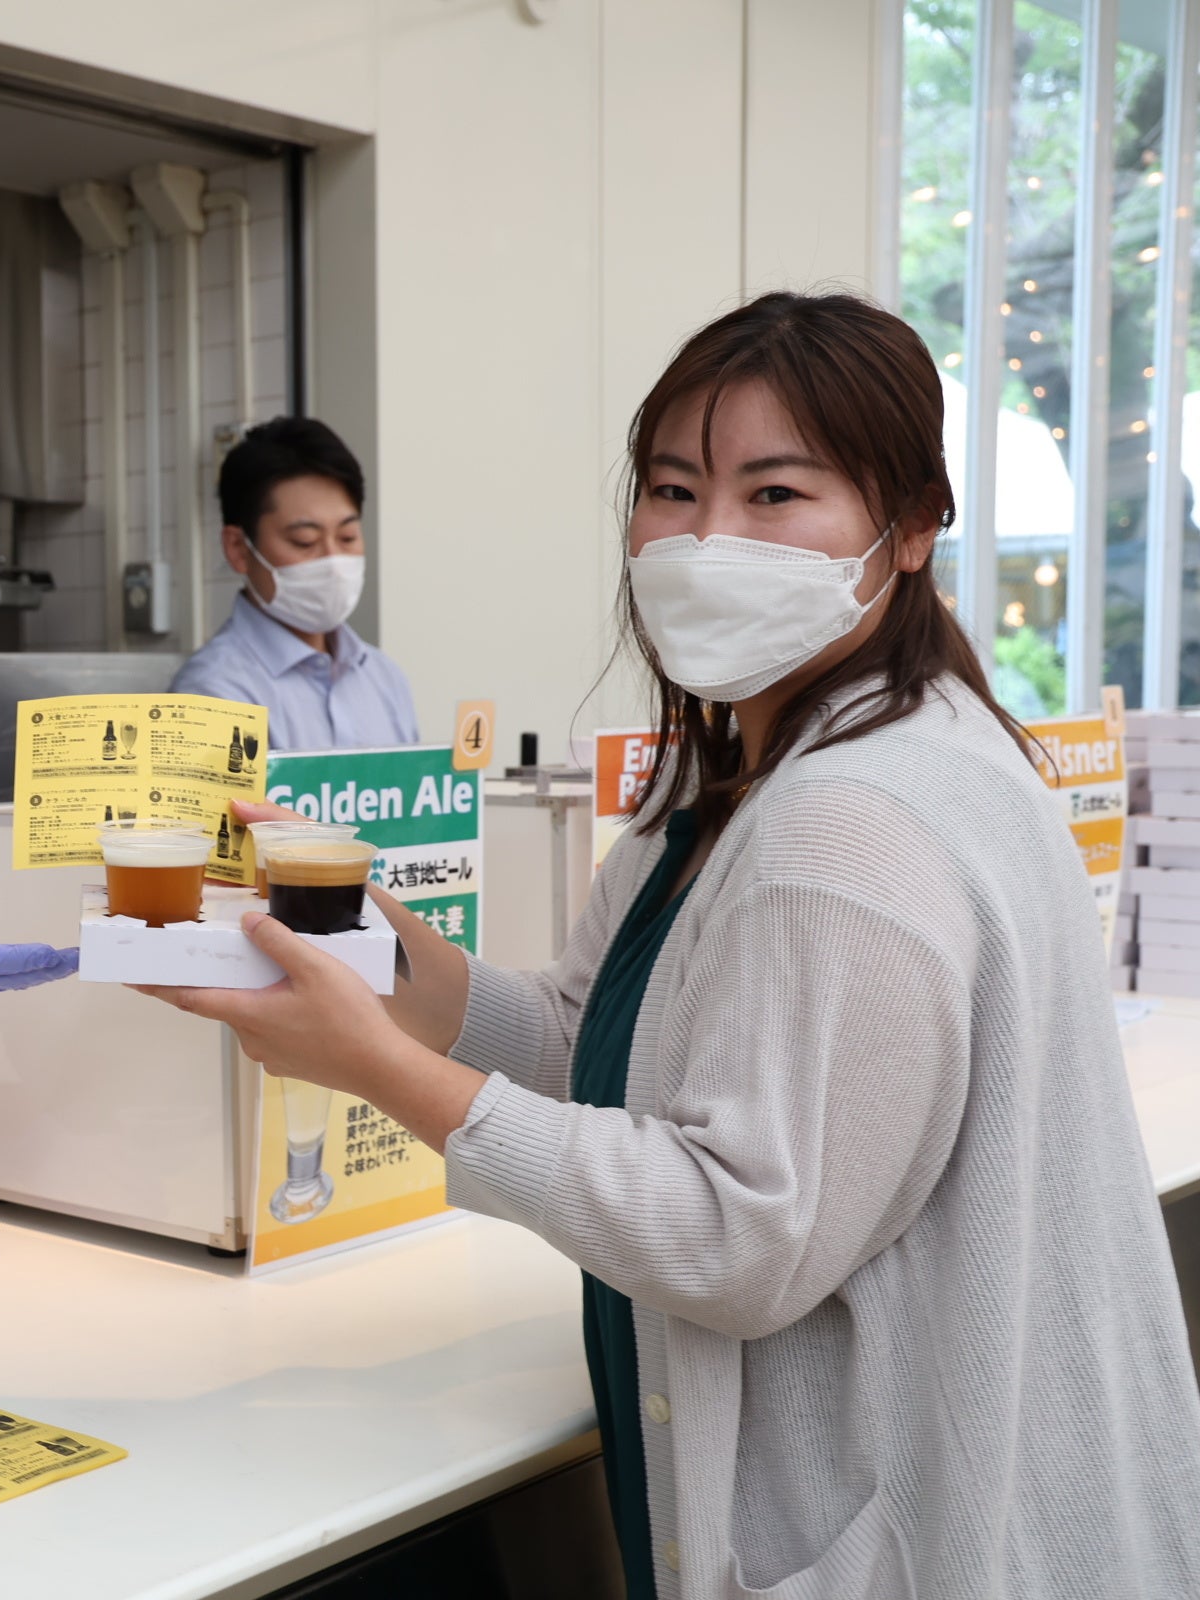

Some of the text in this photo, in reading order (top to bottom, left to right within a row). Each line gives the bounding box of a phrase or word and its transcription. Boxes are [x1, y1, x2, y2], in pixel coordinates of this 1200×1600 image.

[465, 717, 484, 750] 4
[268, 774, 473, 824] Golden Ale
[388, 857, 472, 889] 大雪地ビール
